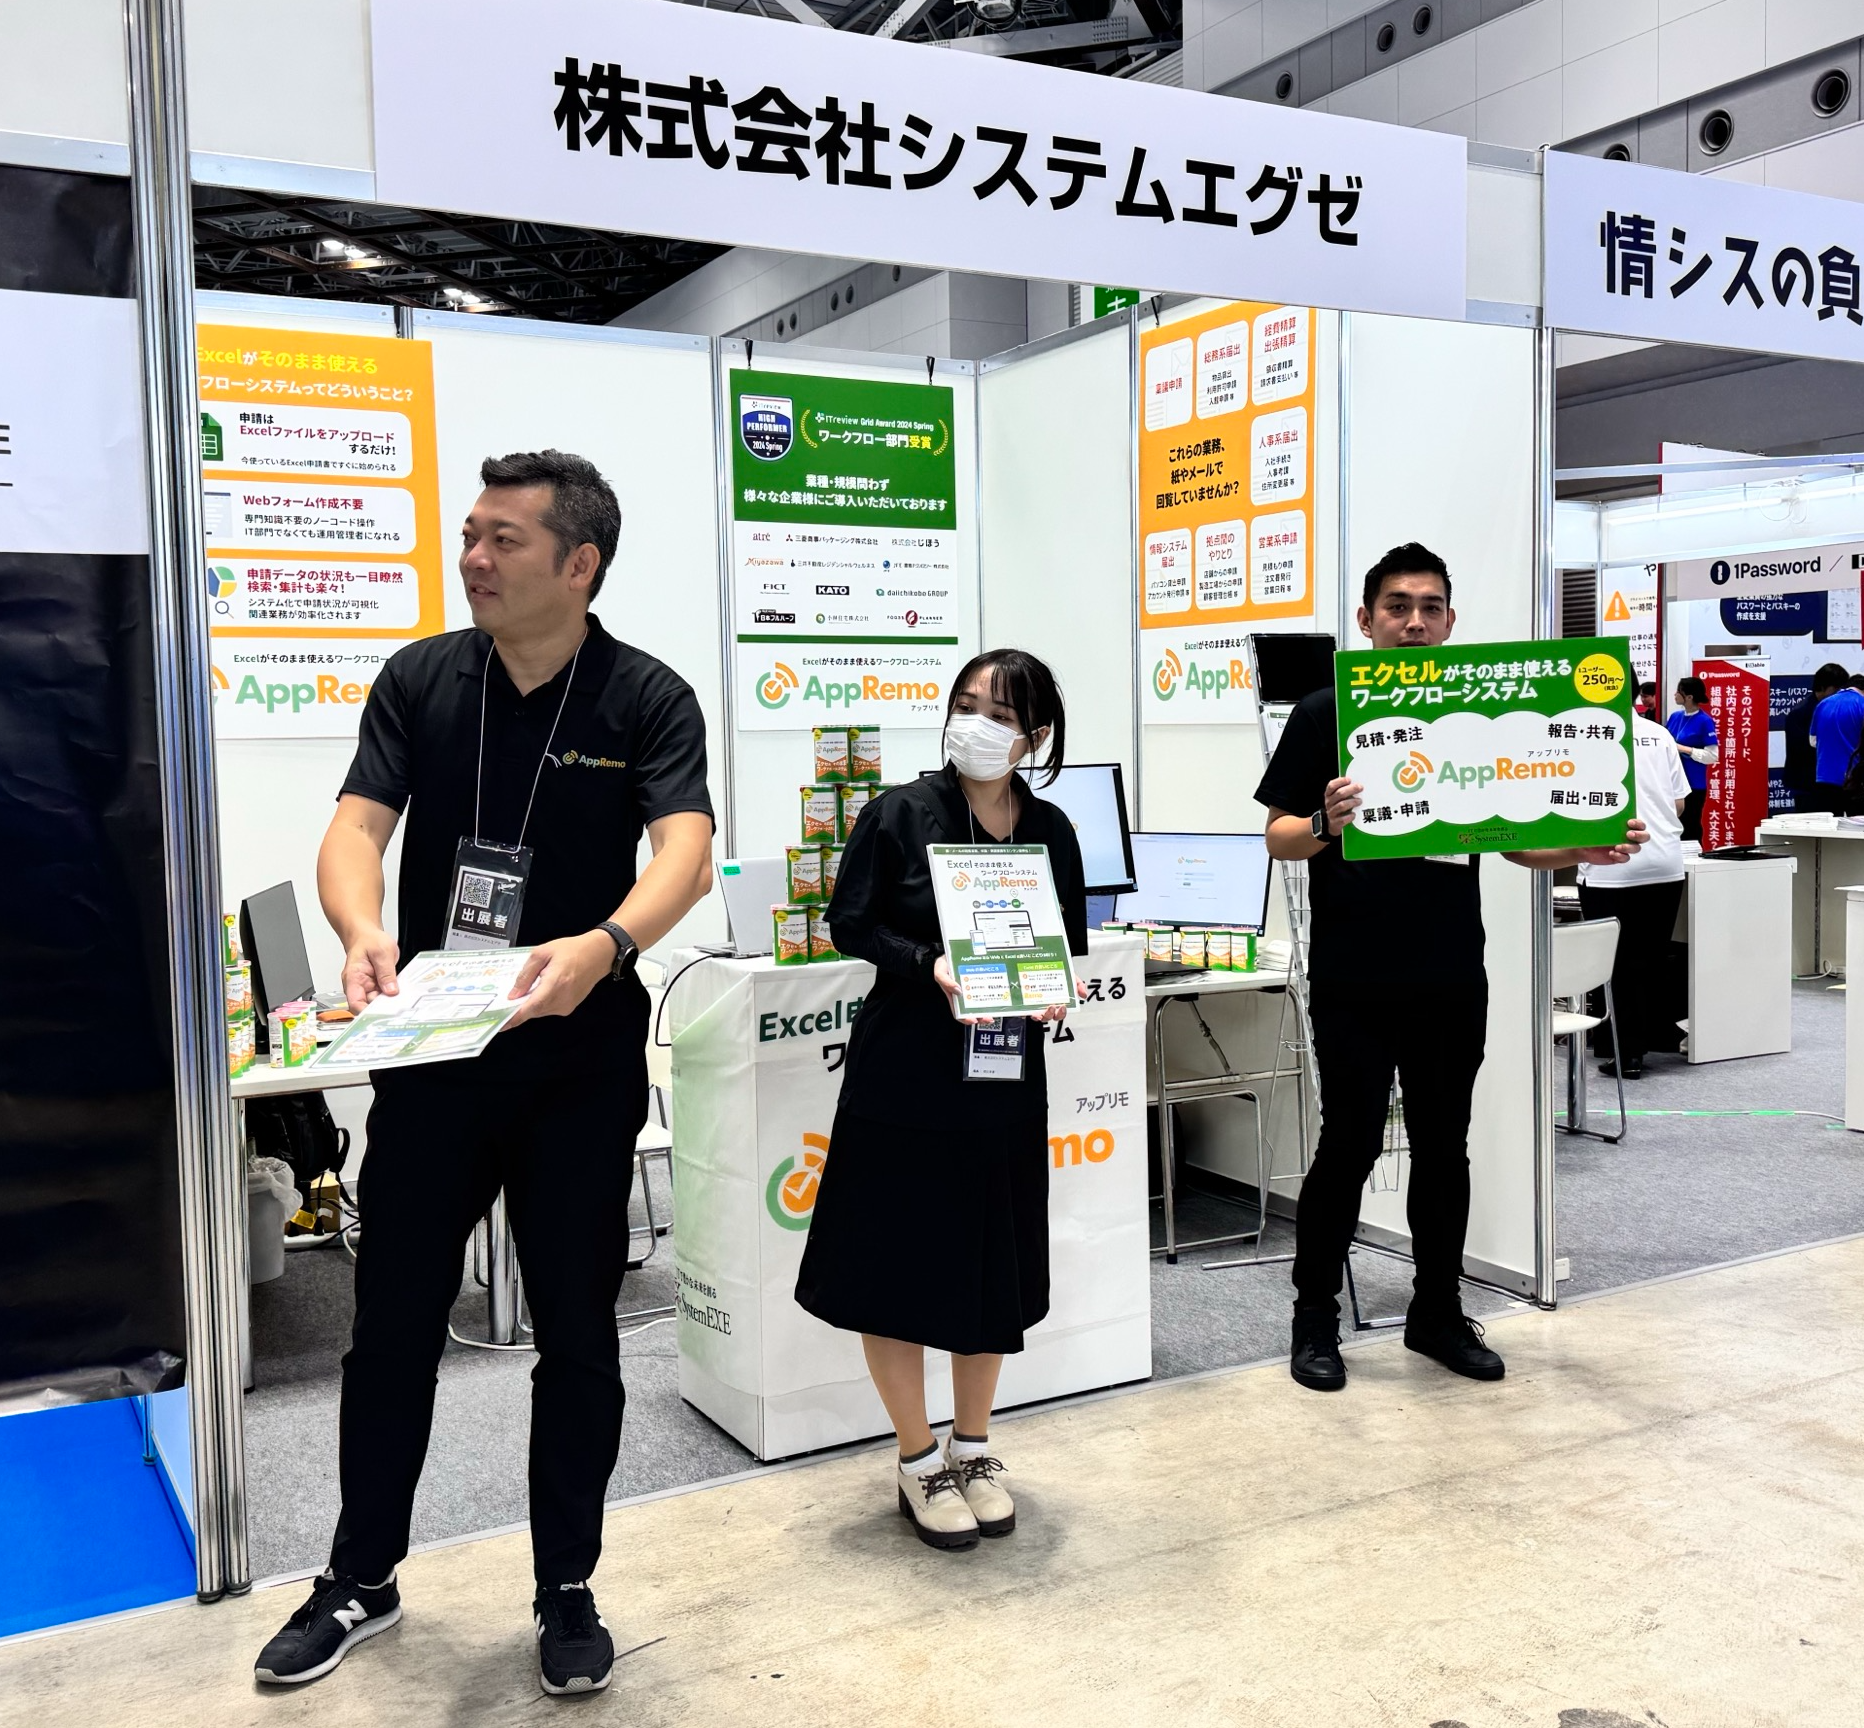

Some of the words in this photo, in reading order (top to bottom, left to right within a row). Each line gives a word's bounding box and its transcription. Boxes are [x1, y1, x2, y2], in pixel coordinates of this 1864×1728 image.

[554, 57, 1363, 247] 株式会社システムエグゼ
[1600, 211, 1864, 326] 情シスの負
[1264, 316, 1297, 337] 経費精算
[1264, 332, 1297, 354] 出張精算
[1204, 343, 1241, 364] 総務系届出
[198, 376, 413, 401] フローシステムってどういうこと?
[239, 412, 274, 425] 申請は
[860, 416, 874, 426] Grid
[875, 418, 895, 428] Award
[896, 420, 912, 429] 2024
[913, 420, 934, 431] Spring
[240, 425, 395, 443] Excelファイルをアップロード
[818, 430, 932, 450] ワークフロー部門受賞
[1259, 430, 1298, 449] 人事系届出
[1171, 461, 1224, 485] 紙やメールで
[806, 474, 890, 491] 業種・規模問わず
[243, 495, 364, 510] Webフォーム作成不要
[744, 489, 947, 511] 様々な企業様にご導入いただいております
[244, 514, 375, 528] 専門知識不要のノーコード操作
[244, 528, 400, 541] IT部門でなくても運用管理者になれる
[1206, 533, 1235, 547] 拠点間の
[1258, 532, 1298, 549] 営業系申請
[1150, 540, 1188, 556] 情報システム
[1208, 548, 1233, 561] やりとり
[1161, 556, 1175, 568] 届出
[1734, 556, 1821, 579] 1Password
[247, 568, 403, 584] 申請データの状況も一目瞭然
[817, 586, 848, 595] KATO
[248, 598, 379, 609] システム化で申請状況が可視化
[248, 609, 361, 620] 関連業務が効率化されます
[1736, 612, 1767, 621] 作成を支援
[802, 657, 942, 666] Excelがそのまま使えるワークフローシステム
[1350, 659, 1572, 687] エクセルがそのまま使える
[235, 674, 373, 713] AppRe
[803, 675, 940, 708] AppRemo
[1351, 680, 1538, 709] ワークフローシステム
[1355, 727, 1423, 749] 見積・発注
[1548, 723, 1616, 740] 報告・共有
[1527, 749, 1570, 758] アップリモ
[579, 757, 626, 769] AppRemo
[1437, 758, 1575, 790] AppRemo
[1550, 790, 1619, 807] 届出・回覧
[973, 876, 1037, 891] AppRemo
[461, 907, 507, 929] 出展者
[979, 1033, 1019, 1047] 出展者
[1076, 1091, 1129, 1114] アップリモ
[681, 1292, 732, 1336] SystemEXE
